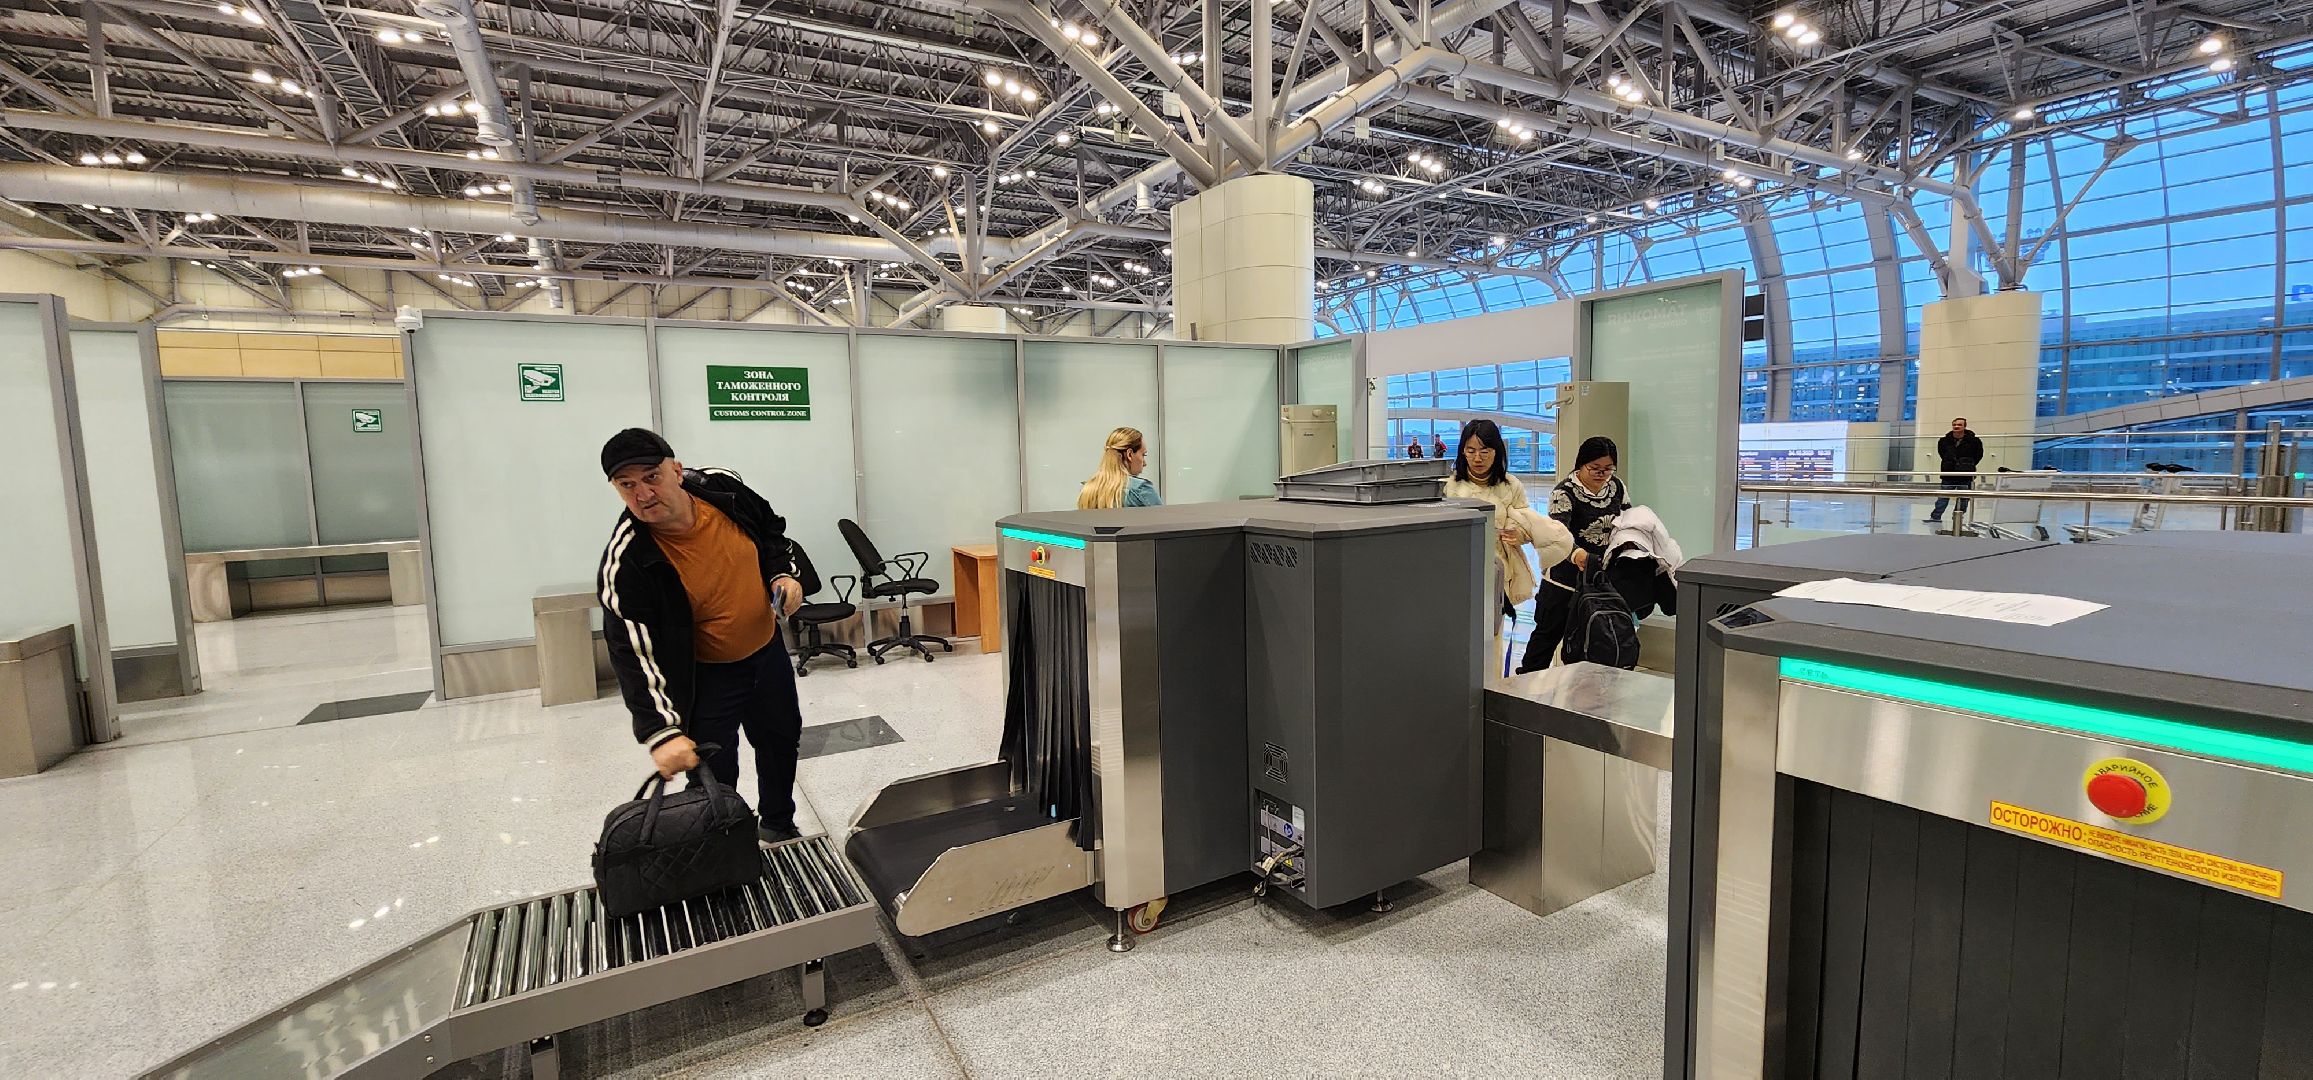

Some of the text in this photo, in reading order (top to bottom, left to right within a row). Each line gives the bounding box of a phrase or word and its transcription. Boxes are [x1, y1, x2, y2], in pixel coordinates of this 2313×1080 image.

[743, 370, 774, 379] ЗОНА
[716, 381, 802, 391] ТАМОЖЕННОГО
[731, 392, 790, 402] КОНТРОЛЯ
[2093, 764, 2159, 789] ВАРИЙНОЕ
[1993, 806, 2087, 843] ОСТОРОЖНО:
[2087, 837, 2138, 857] ОПАСНОСТЬ
